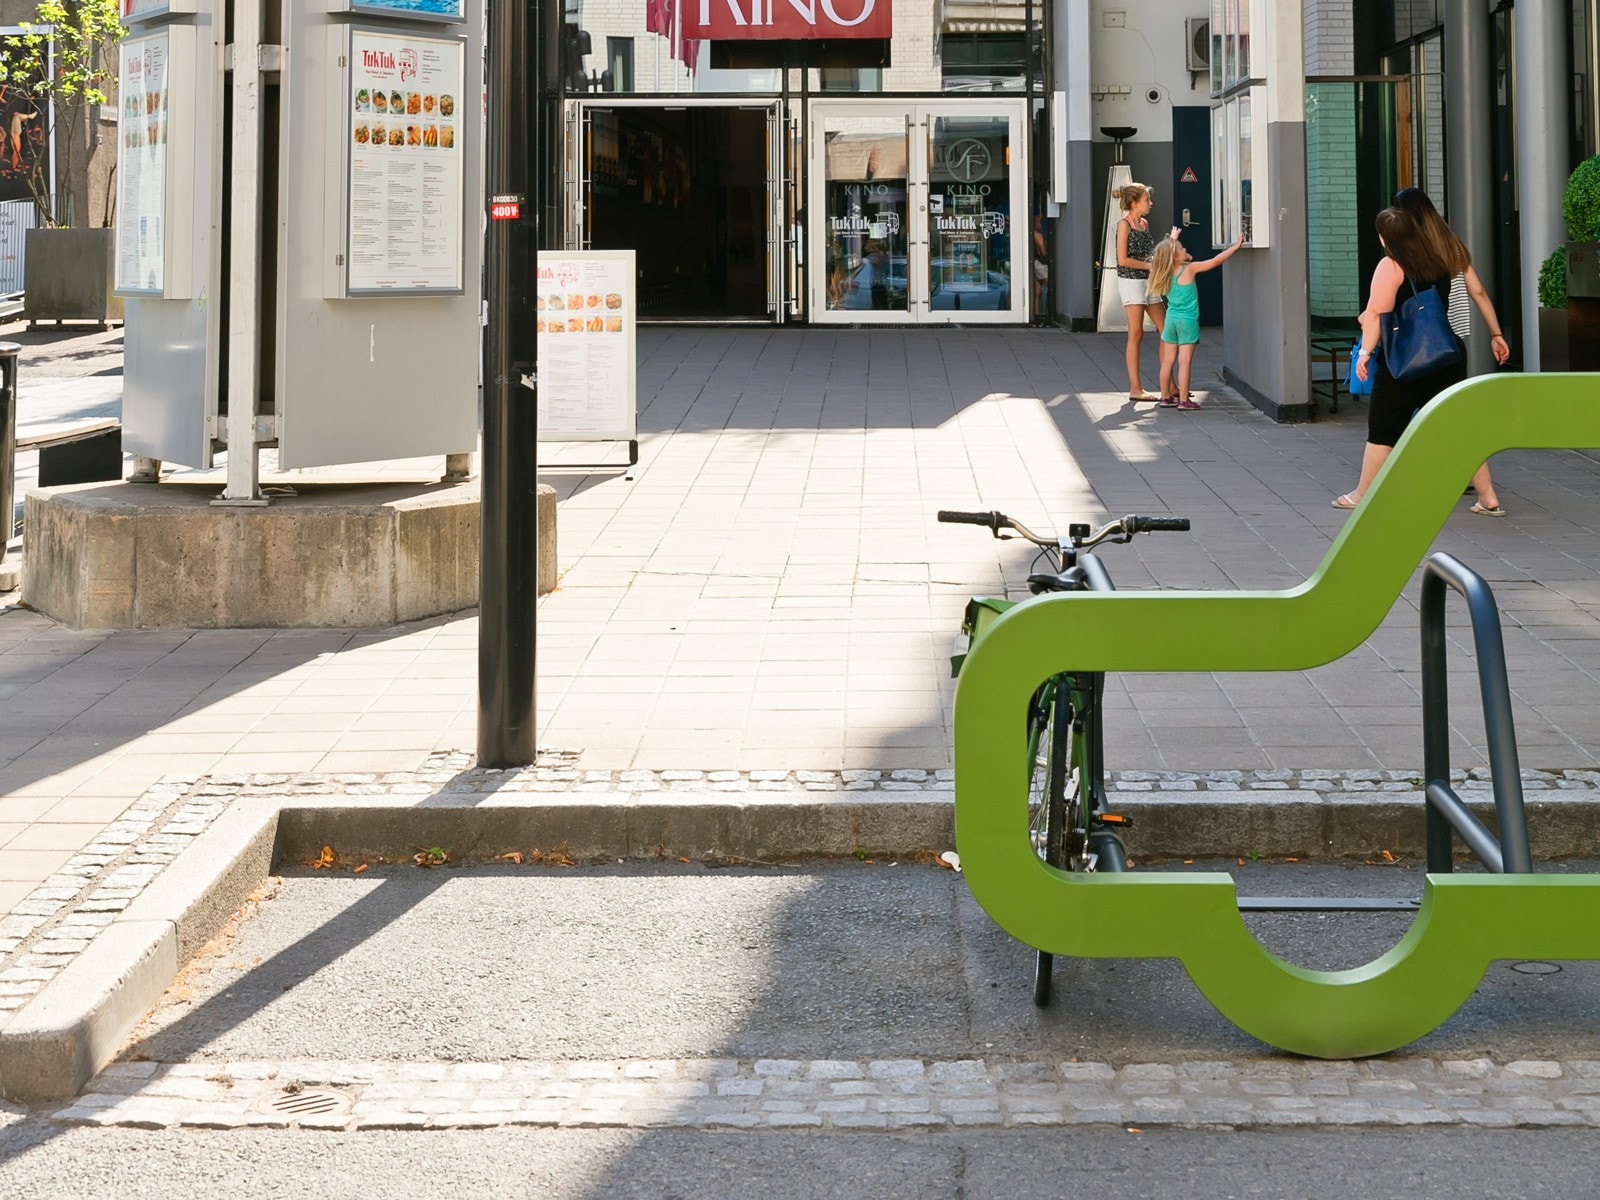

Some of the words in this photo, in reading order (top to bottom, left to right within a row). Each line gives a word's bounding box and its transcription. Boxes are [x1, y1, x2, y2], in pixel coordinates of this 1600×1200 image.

[362, 50, 396, 69] TukTuk
[844, 184, 888, 196] KINO
[946, 184, 992, 196] KINO
[830, 216, 871, 230] TukTuk
[935, 216, 977, 230] TukTuk
